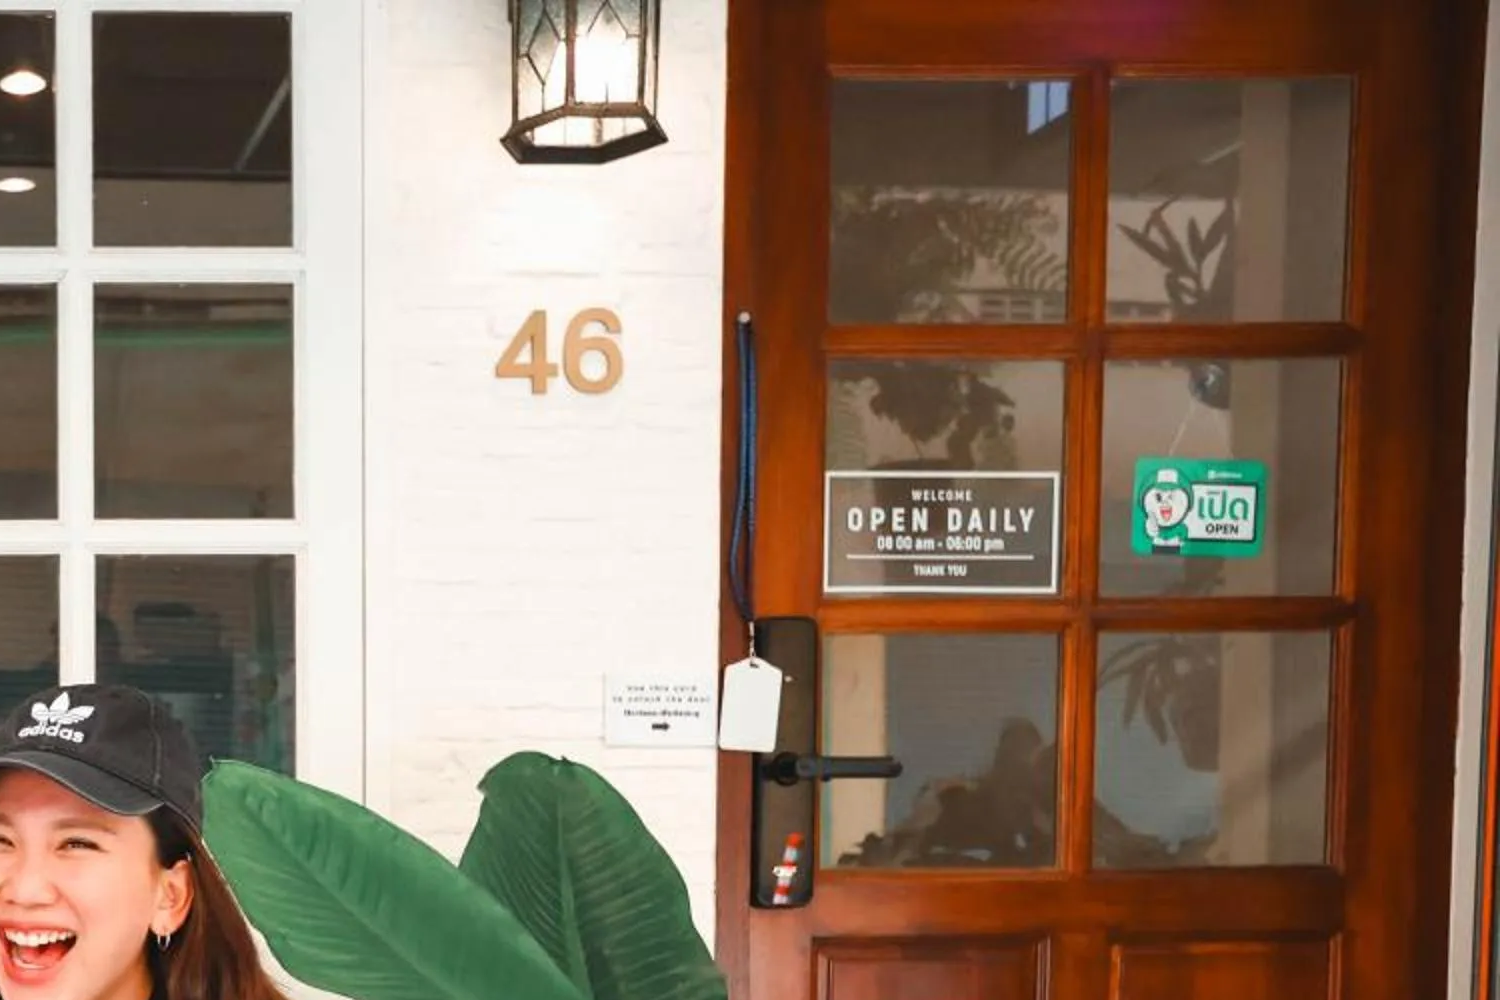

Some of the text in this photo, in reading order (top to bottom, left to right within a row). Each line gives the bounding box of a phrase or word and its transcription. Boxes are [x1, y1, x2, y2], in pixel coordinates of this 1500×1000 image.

[495, 307, 623, 395] 46
[911, 489, 972, 501] WELCOME
[1197, 490, 1249, 520] เปิด
[847, 507, 1034, 532] OPEN DAILY
[1205, 524, 1239, 534] OPEN
[915, 538, 935, 551] am
[984, 538, 1005, 553] pm
[913, 564, 967, 576] THANK YOU
[18, 720, 84, 743] adidas
